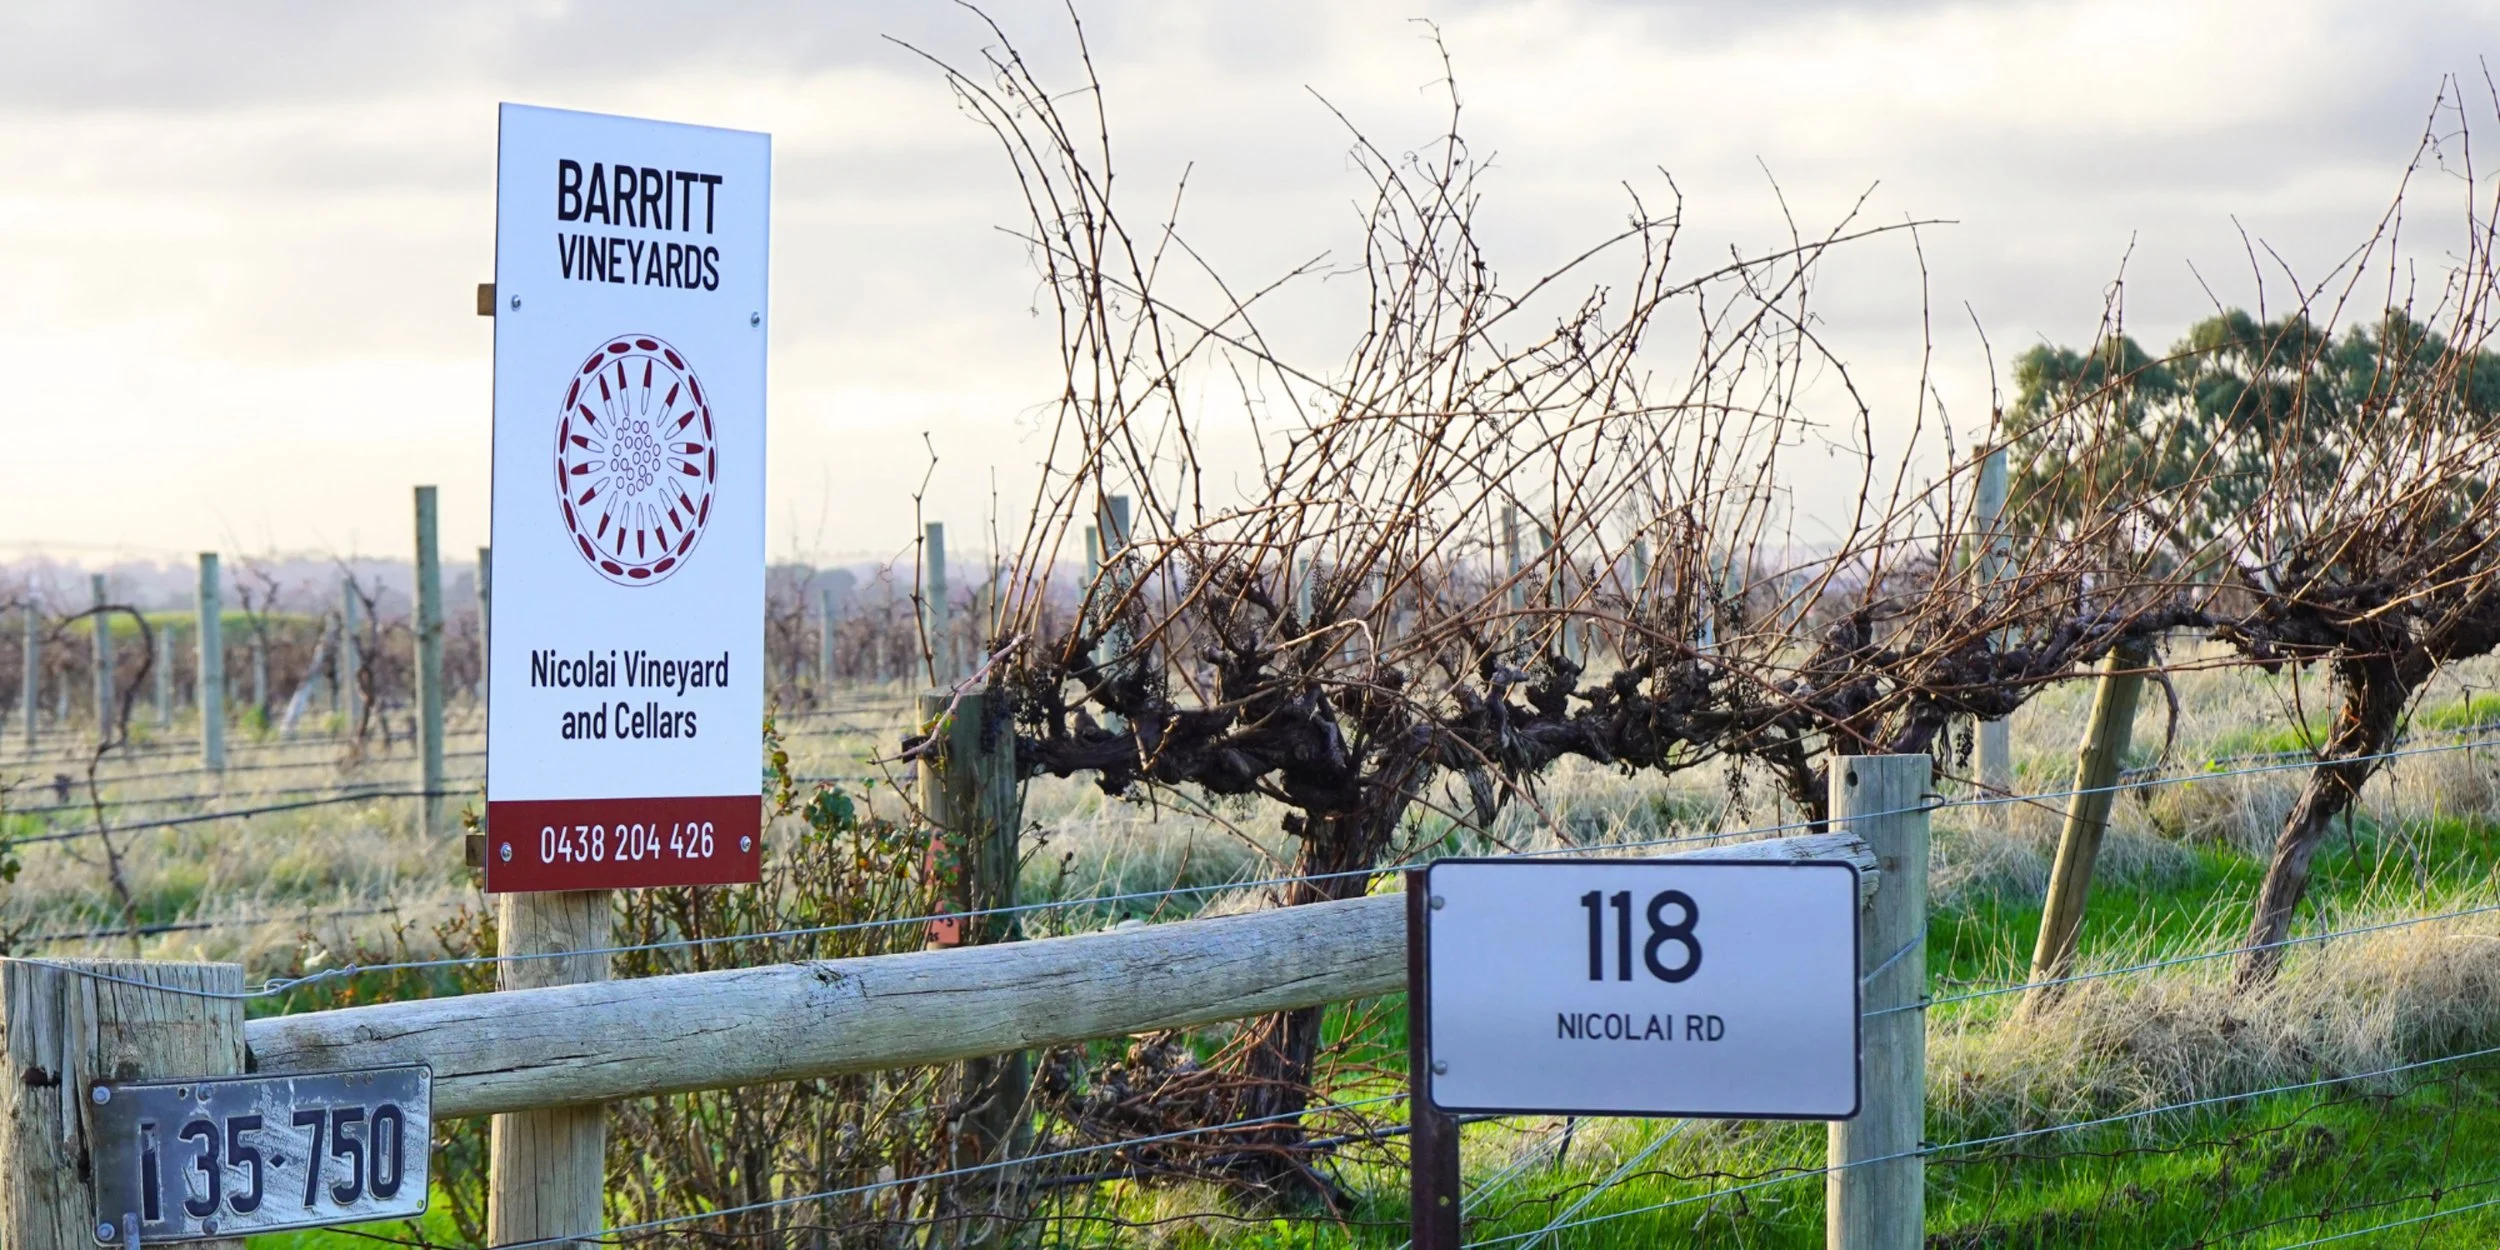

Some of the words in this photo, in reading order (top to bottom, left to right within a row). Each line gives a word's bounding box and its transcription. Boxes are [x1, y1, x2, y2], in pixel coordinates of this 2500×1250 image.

[557, 158, 723, 235] BARRITT
[557, 232, 720, 292] VINEYARDS
[531, 649, 617, 688] Nicolai
[623, 650, 729, 698] Vineyard
[561, 701, 607, 740] and
[614, 701, 697, 740] Cellars
[540, 824, 605, 864] 0438
[614, 823, 661, 861] 204
[669, 821, 714, 859] 426
[1580, 889, 1703, 984] 118
[1557, 1012, 1673, 1041] NICOLAI
[1686, 1014, 1725, 1042] RD
